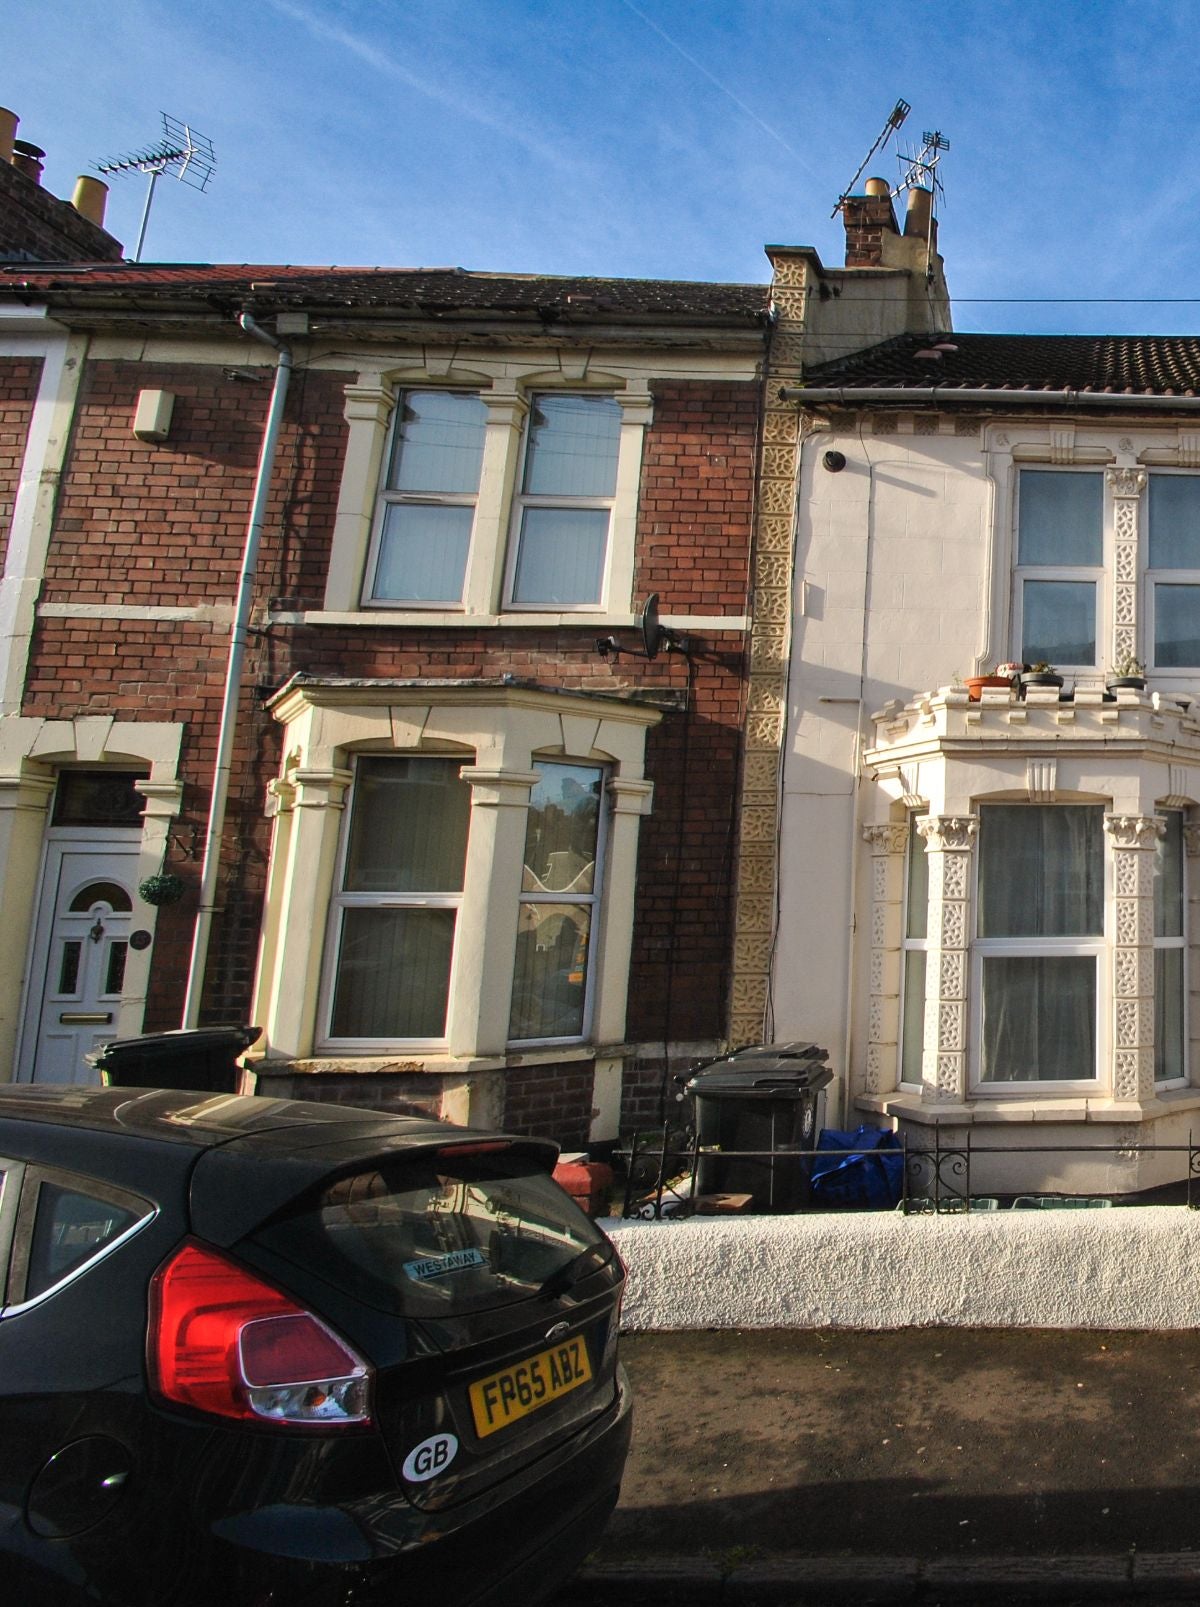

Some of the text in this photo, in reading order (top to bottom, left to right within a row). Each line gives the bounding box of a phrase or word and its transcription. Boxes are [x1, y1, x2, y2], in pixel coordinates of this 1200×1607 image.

[412, 1251, 477, 1276] WESTAWAY
[482, 1342, 585, 1425] FP65 ABZ
[413, 1439, 449, 1475] GB
